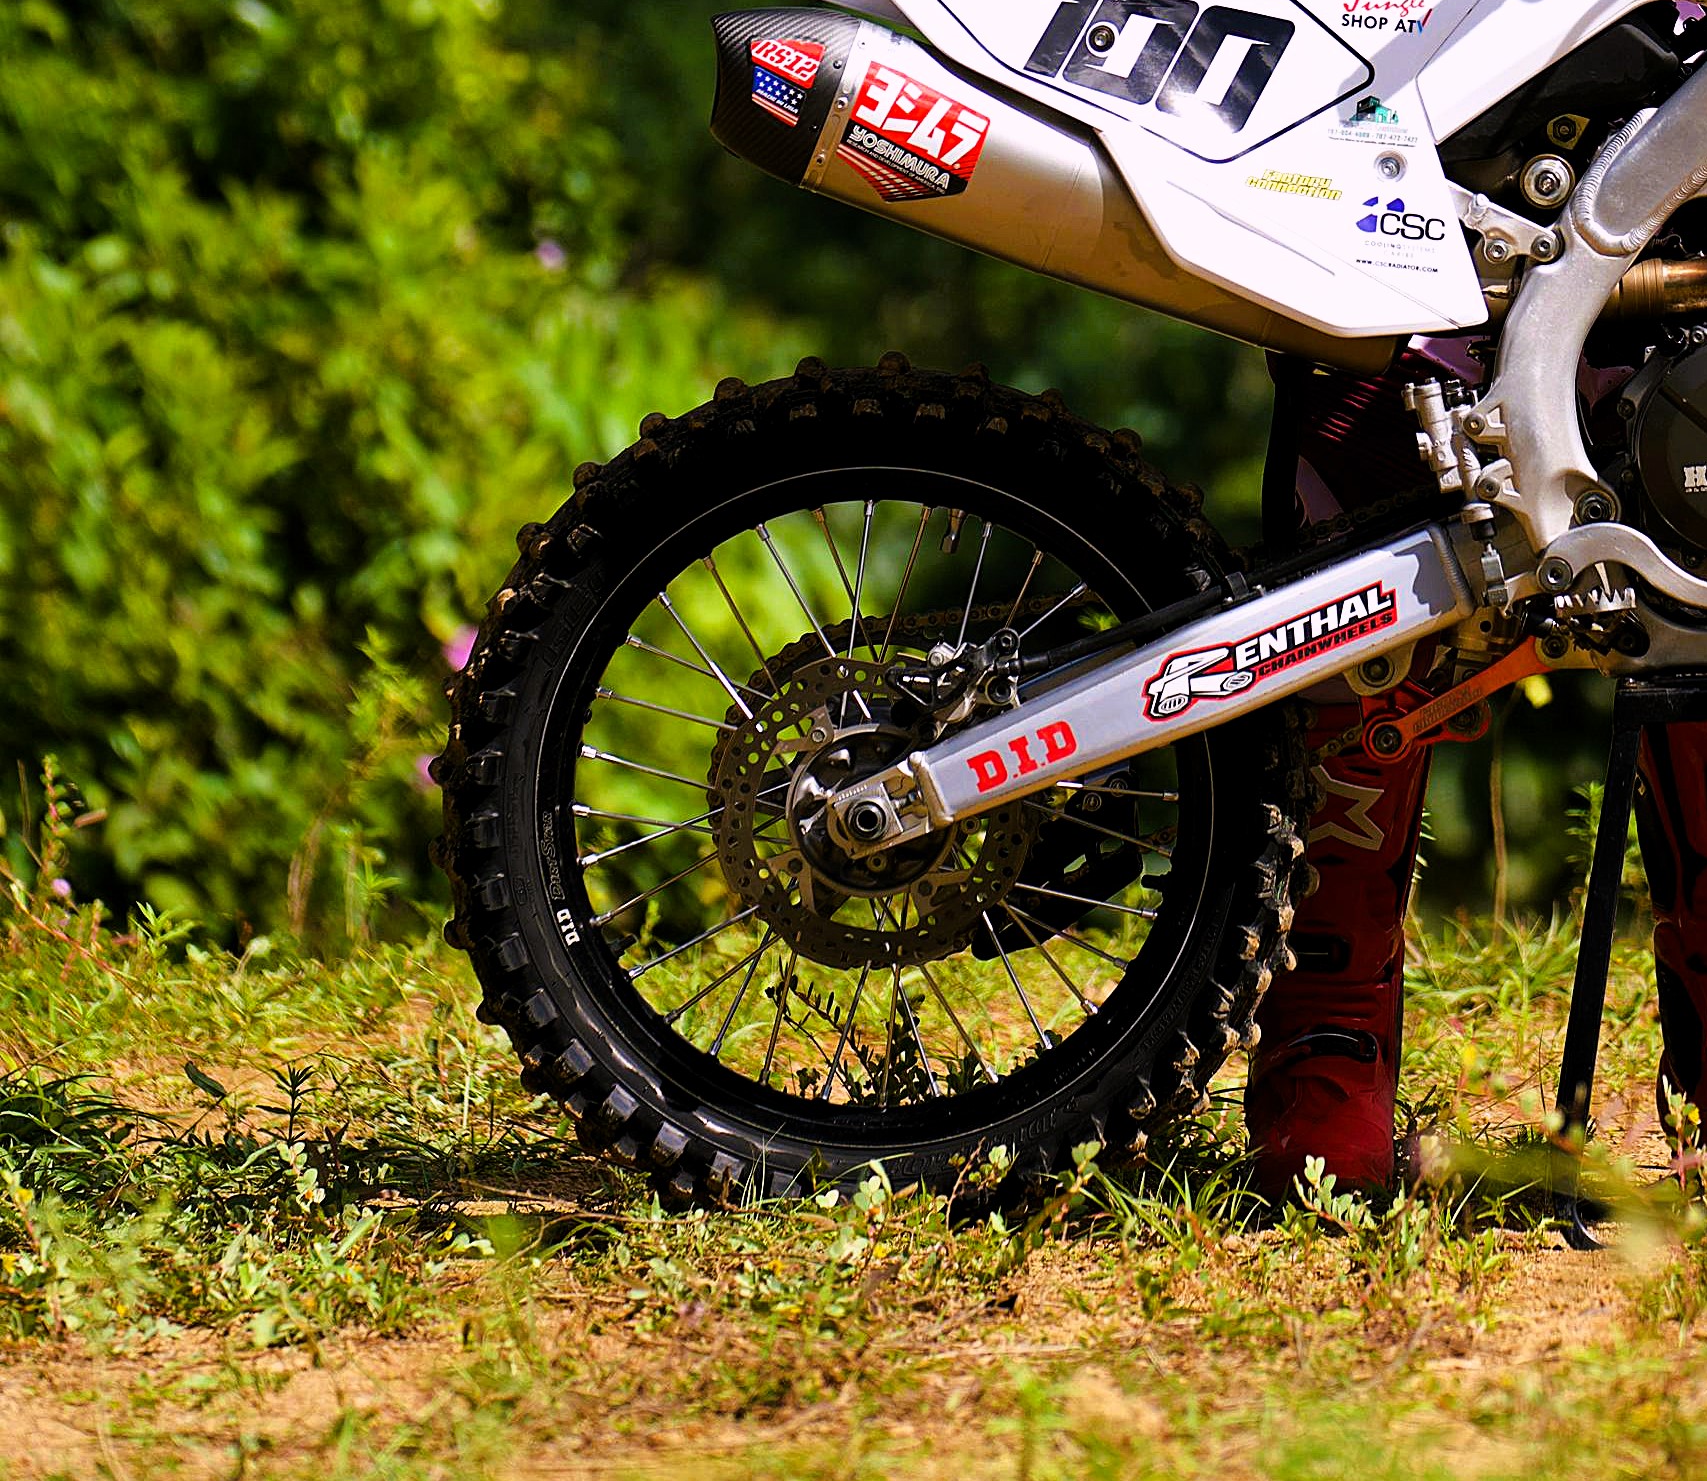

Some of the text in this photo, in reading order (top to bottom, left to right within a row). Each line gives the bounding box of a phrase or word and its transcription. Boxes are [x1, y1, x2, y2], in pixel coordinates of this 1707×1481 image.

[1341, 8, 1433, 34] SHOP ATV
[783, 100, 799, 114] USA
[849, 124, 951, 189] YOSHIMURA
[1380, 212, 1446, 241] CSC
[1148, 586, 1393, 717] RENTHAL
[1258, 612, 1394, 677] CHAINWHEELS
